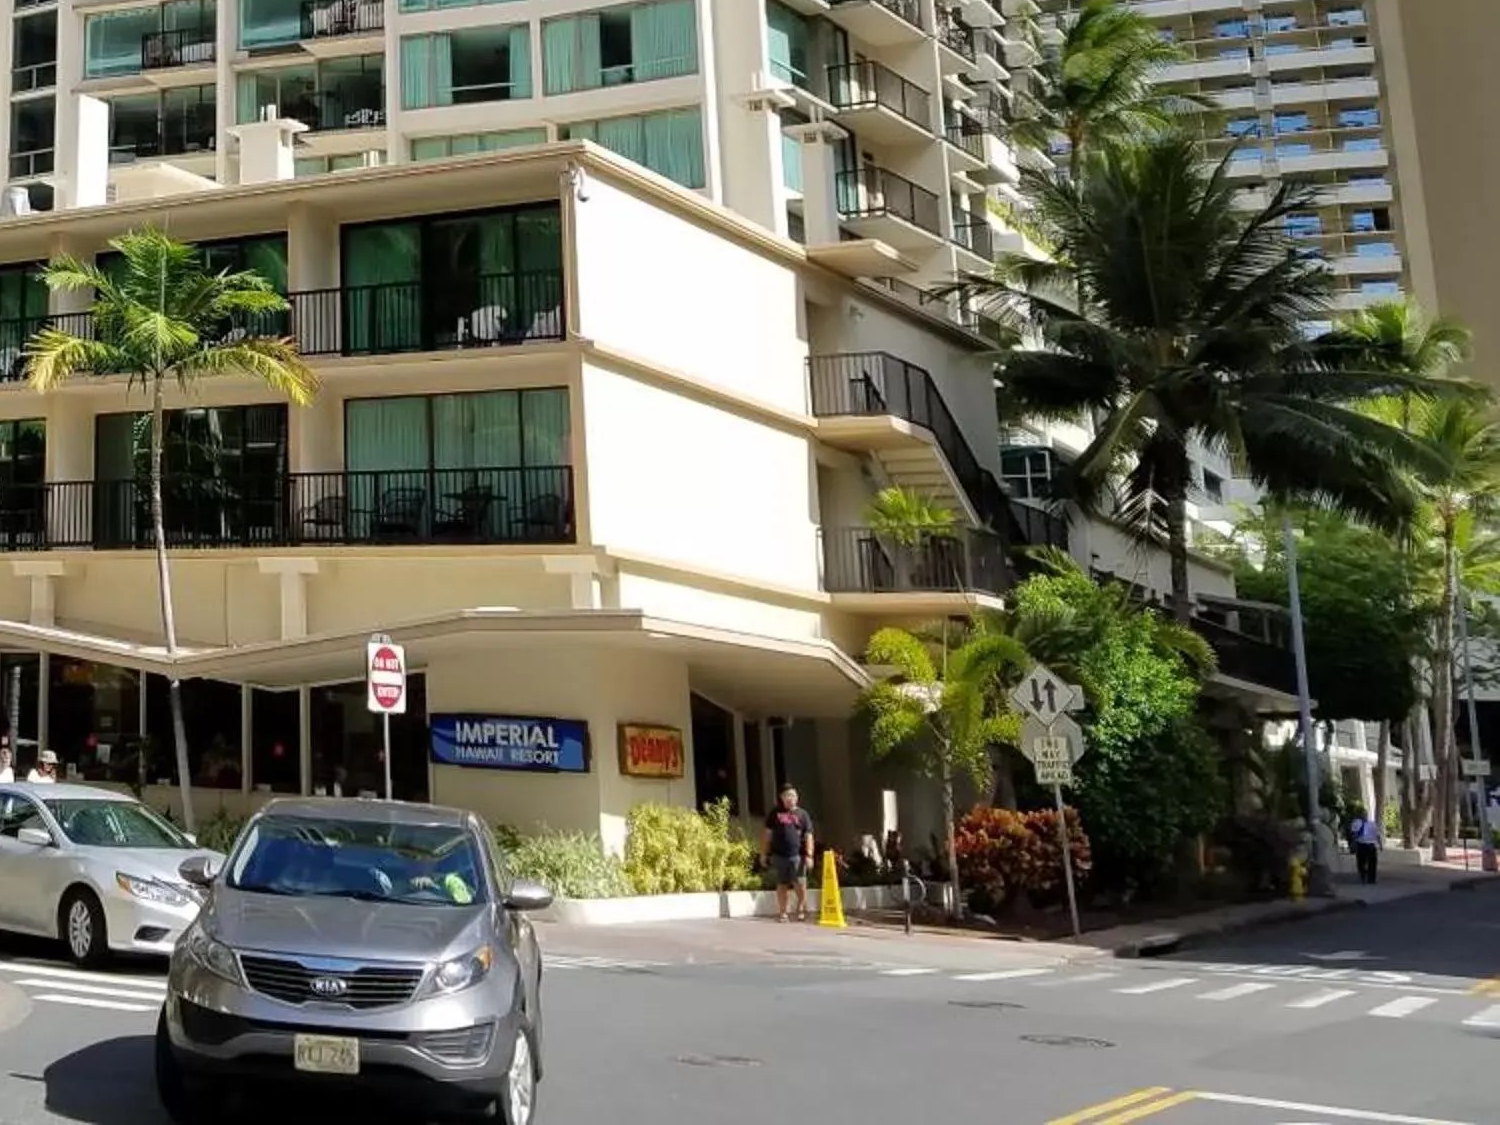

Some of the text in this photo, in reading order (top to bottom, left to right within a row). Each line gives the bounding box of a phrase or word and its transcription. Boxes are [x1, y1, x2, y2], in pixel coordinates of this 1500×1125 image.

[374, 657, 399, 670] DO NOT
[377, 686, 399, 698] ENTER
[455, 721, 558, 748] IMPERIAL
[454, 747, 560, 764] HAWAII RESORT
[314, 978, 346, 993] KIA
